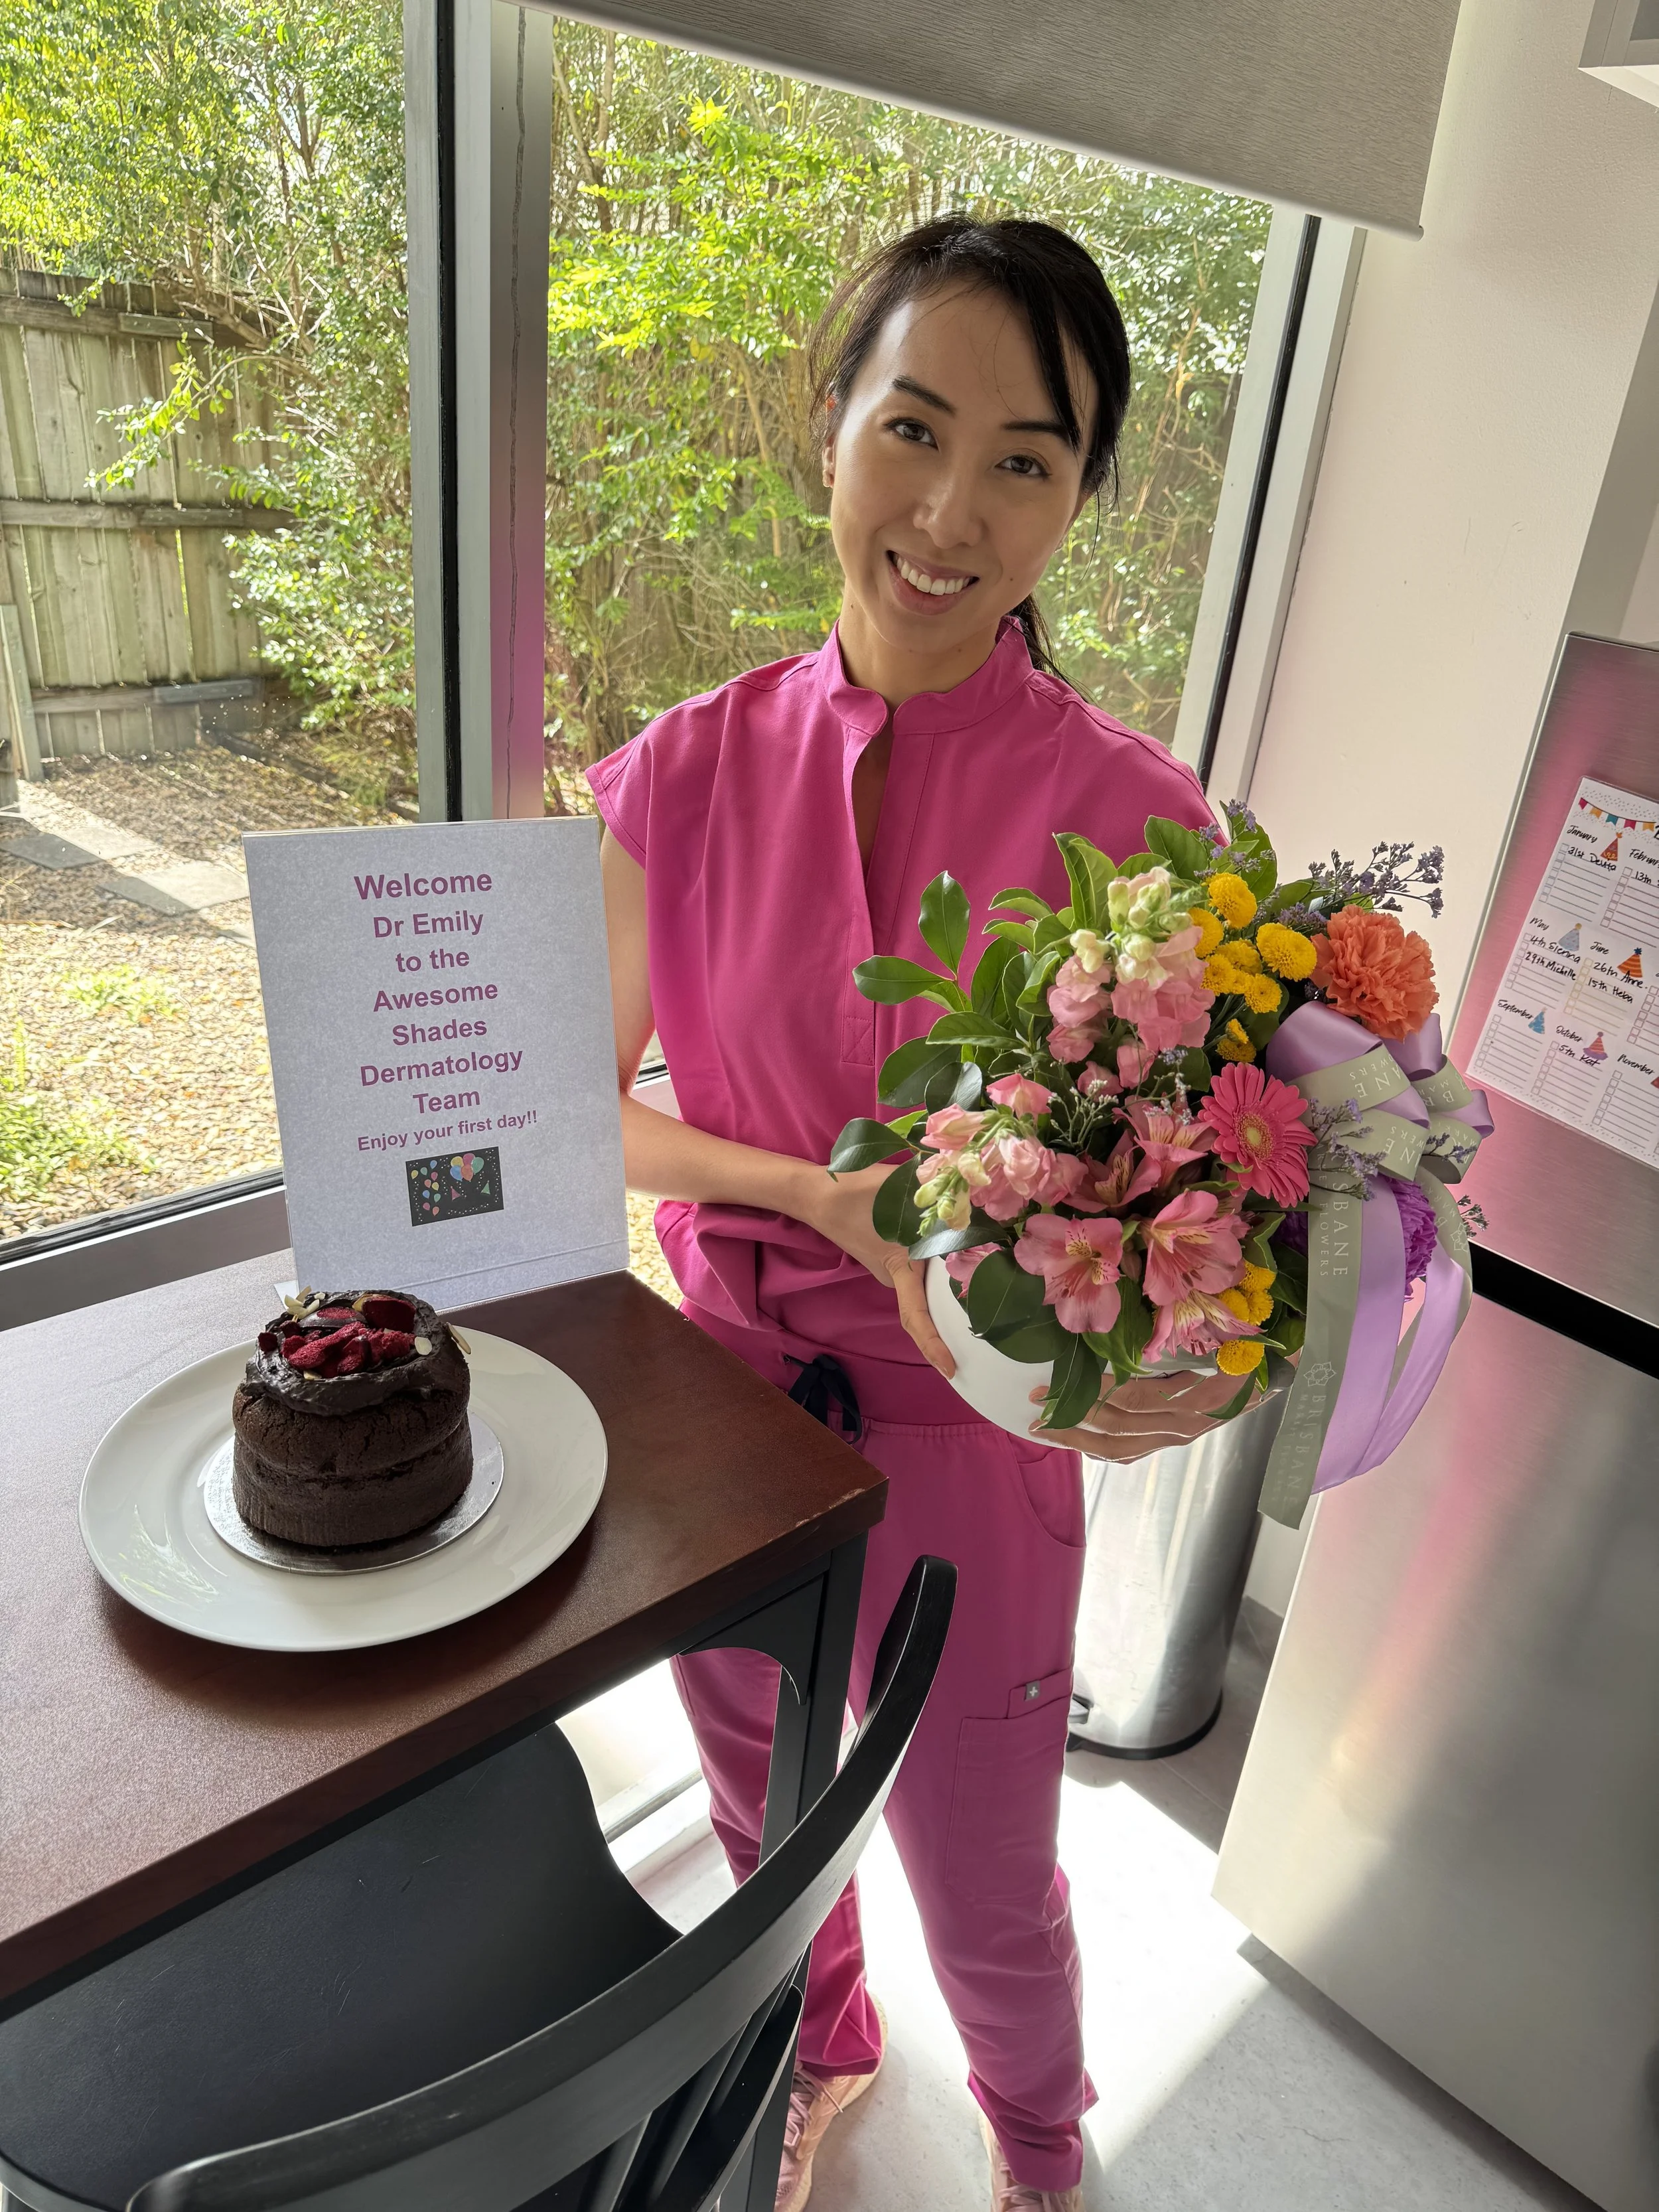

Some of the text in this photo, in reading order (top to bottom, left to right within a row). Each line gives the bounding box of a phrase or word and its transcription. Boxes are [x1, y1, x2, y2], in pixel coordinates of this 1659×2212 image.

[1567, 825, 1598, 843] January
[1568, 847, 1584, 859] 31st
[354, 873, 492, 900] Welcome
[374, 910, 483, 938] Dr Emily
[1530, 917, 1549, 930] May
[1530, 935, 1546, 948] 4th
[1590, 941, 1609, 954] June
[396, 948, 470, 972] to the
[1525, 952, 1576, 980] 29th Michelle
[1593, 962, 1618, 977] 26th
[1588, 977, 1607, 992] 15th
[374, 984, 498, 1012] Awesome
[1498, 999, 1534, 1019] September
[392, 1019, 488, 1046] Shades
[1556, 1025, 1583, 1043] October
[1559, 1045, 1575, 1057] 5th
[360, 1051, 523, 1086] Dermatology
[1617, 1054, 1655, 1074] November
[413, 1090, 480, 1114] Team
[358, 1110, 538, 1151] Enjoy your first day!!
[1319, 1203, 1329, 1276] FLOWERS
